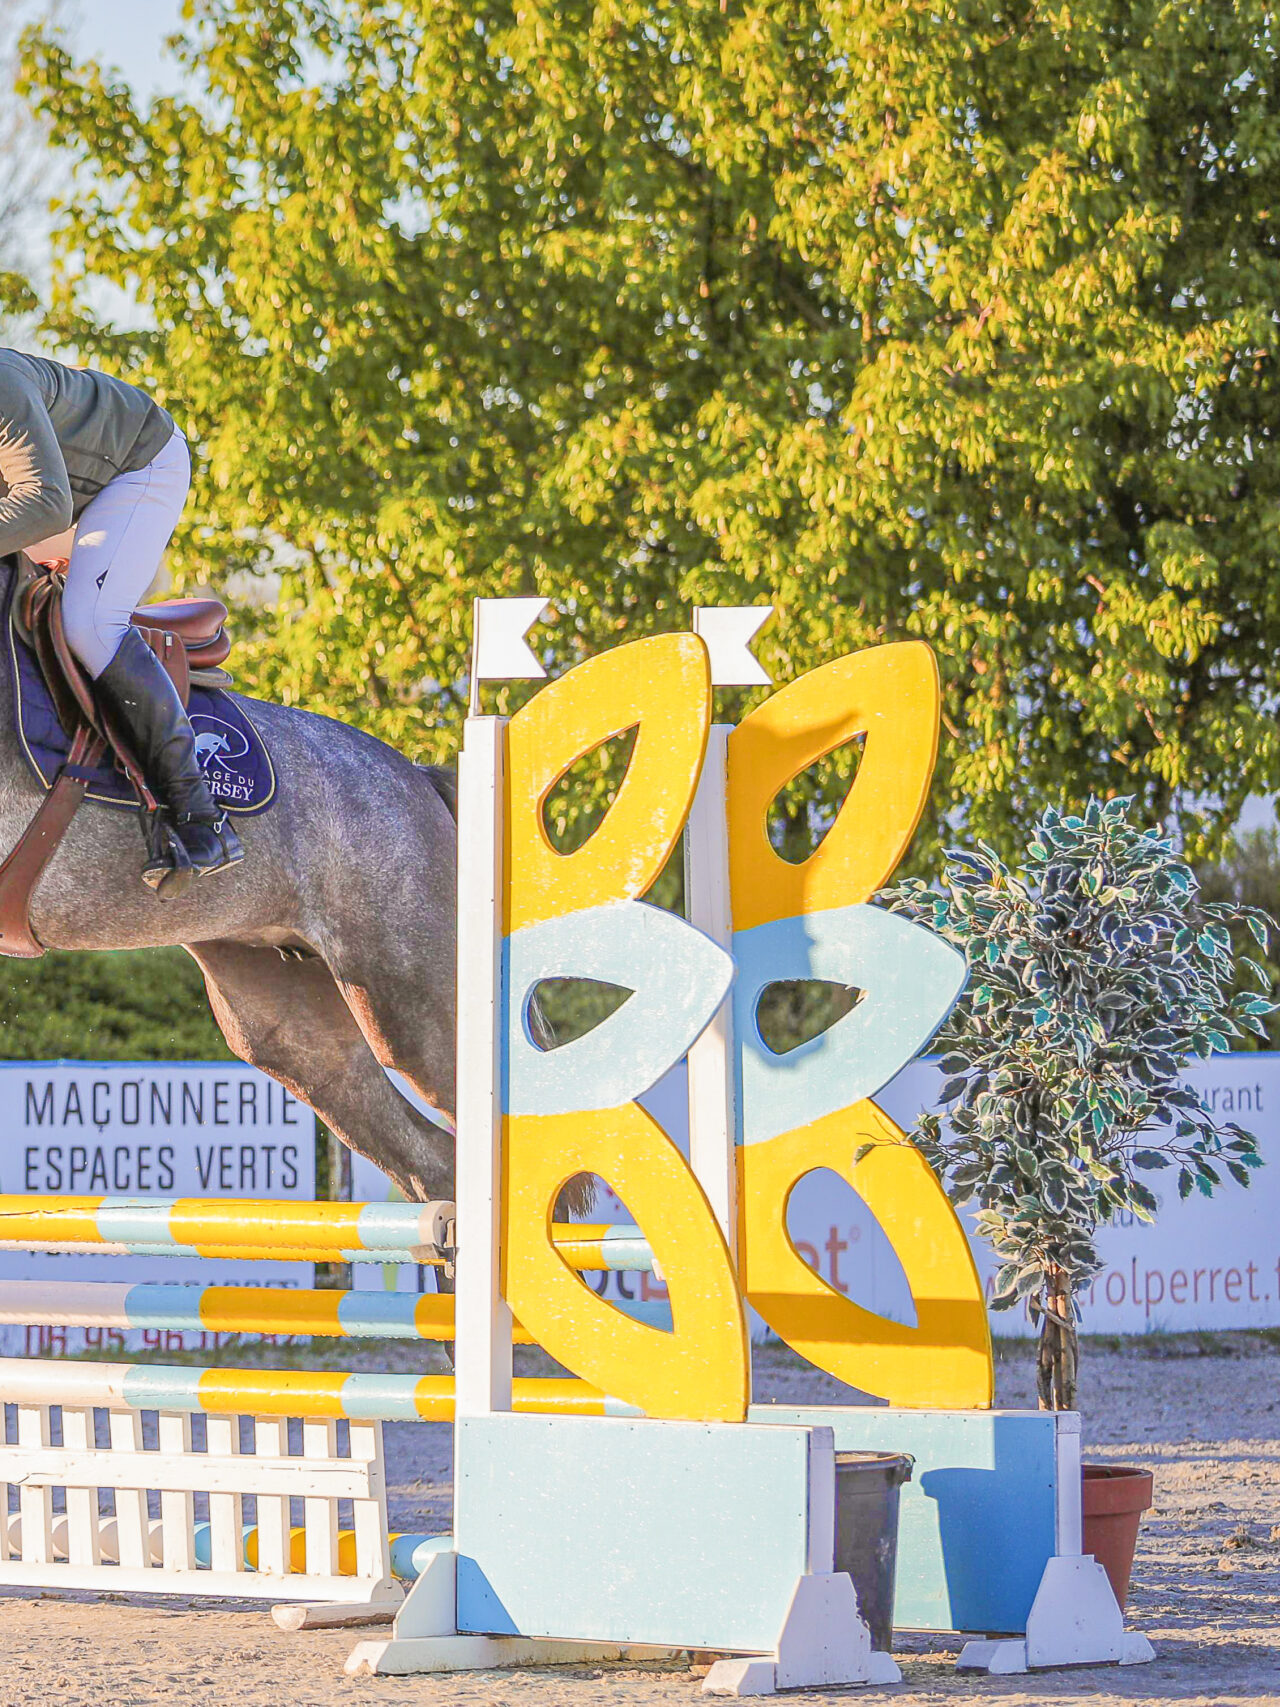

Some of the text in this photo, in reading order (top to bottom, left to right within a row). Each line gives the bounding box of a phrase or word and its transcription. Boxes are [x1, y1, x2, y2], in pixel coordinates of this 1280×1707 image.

[238, 776, 254, 787] DU
[25, 1081, 298, 1132] MAÇONNERIE
[25, 1146, 298, 1190] ESPACES VERTS
